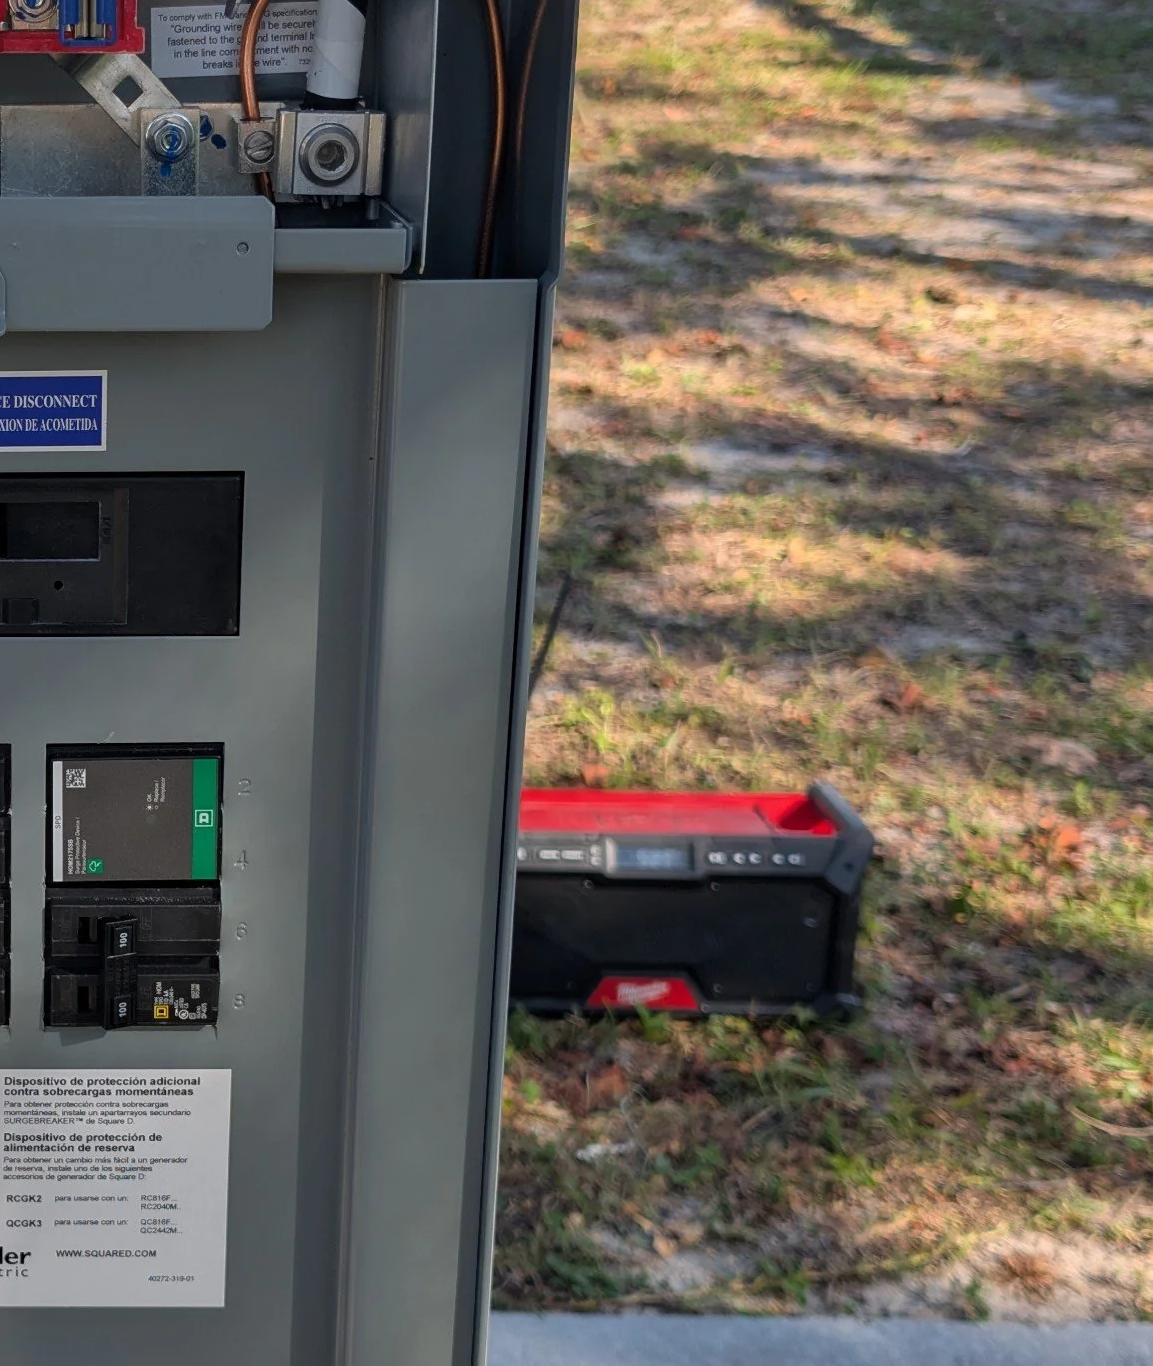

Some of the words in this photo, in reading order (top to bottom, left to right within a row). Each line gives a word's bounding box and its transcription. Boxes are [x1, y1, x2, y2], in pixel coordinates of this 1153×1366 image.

[170, 14, 195, 22] comply
[171, 24, 220, 33] "Grounding
[168, 38, 206, 46] fastened
[220, 36, 234, 44] the
[271, 32, 307, 42] terminal
[184, 49, 198, 57] the
[201, 48, 216, 56] line
[281, 45, 299, 53] with
[203, 61, 233, 69] breaks
[14, 395, 97, 408] DISCONNECT
[25, 419, 37, 431] DE
[40, 418, 98, 431] ACOMETIDA
[119, 933, 127, 948] 100
[119, 1003, 127, 1018] 100
[4, 1077, 66, 1087] Dispositivo
[70, 1077, 83, 1086] de
[87, 1077, 146, 1087] protección
[150, 1077, 200, 1086] adicional
[4, 1088, 40, 1096] contra
[42, 1088, 112, 1097] sobrecargas
[115, 1087, 194, 1096] momentáneas
[4, 1133, 66, 1143] Dispositivo
[70, 1133, 83, 1141] de
[86, 1134, 145, 1143] protección
[4, 1143, 74, 1152] alimentación
[78, 1144, 91, 1152] de
[6, 1220, 42, 1228] QCGK3
[56, 1250, 157, 1258] WWW.SQUARED.COM
